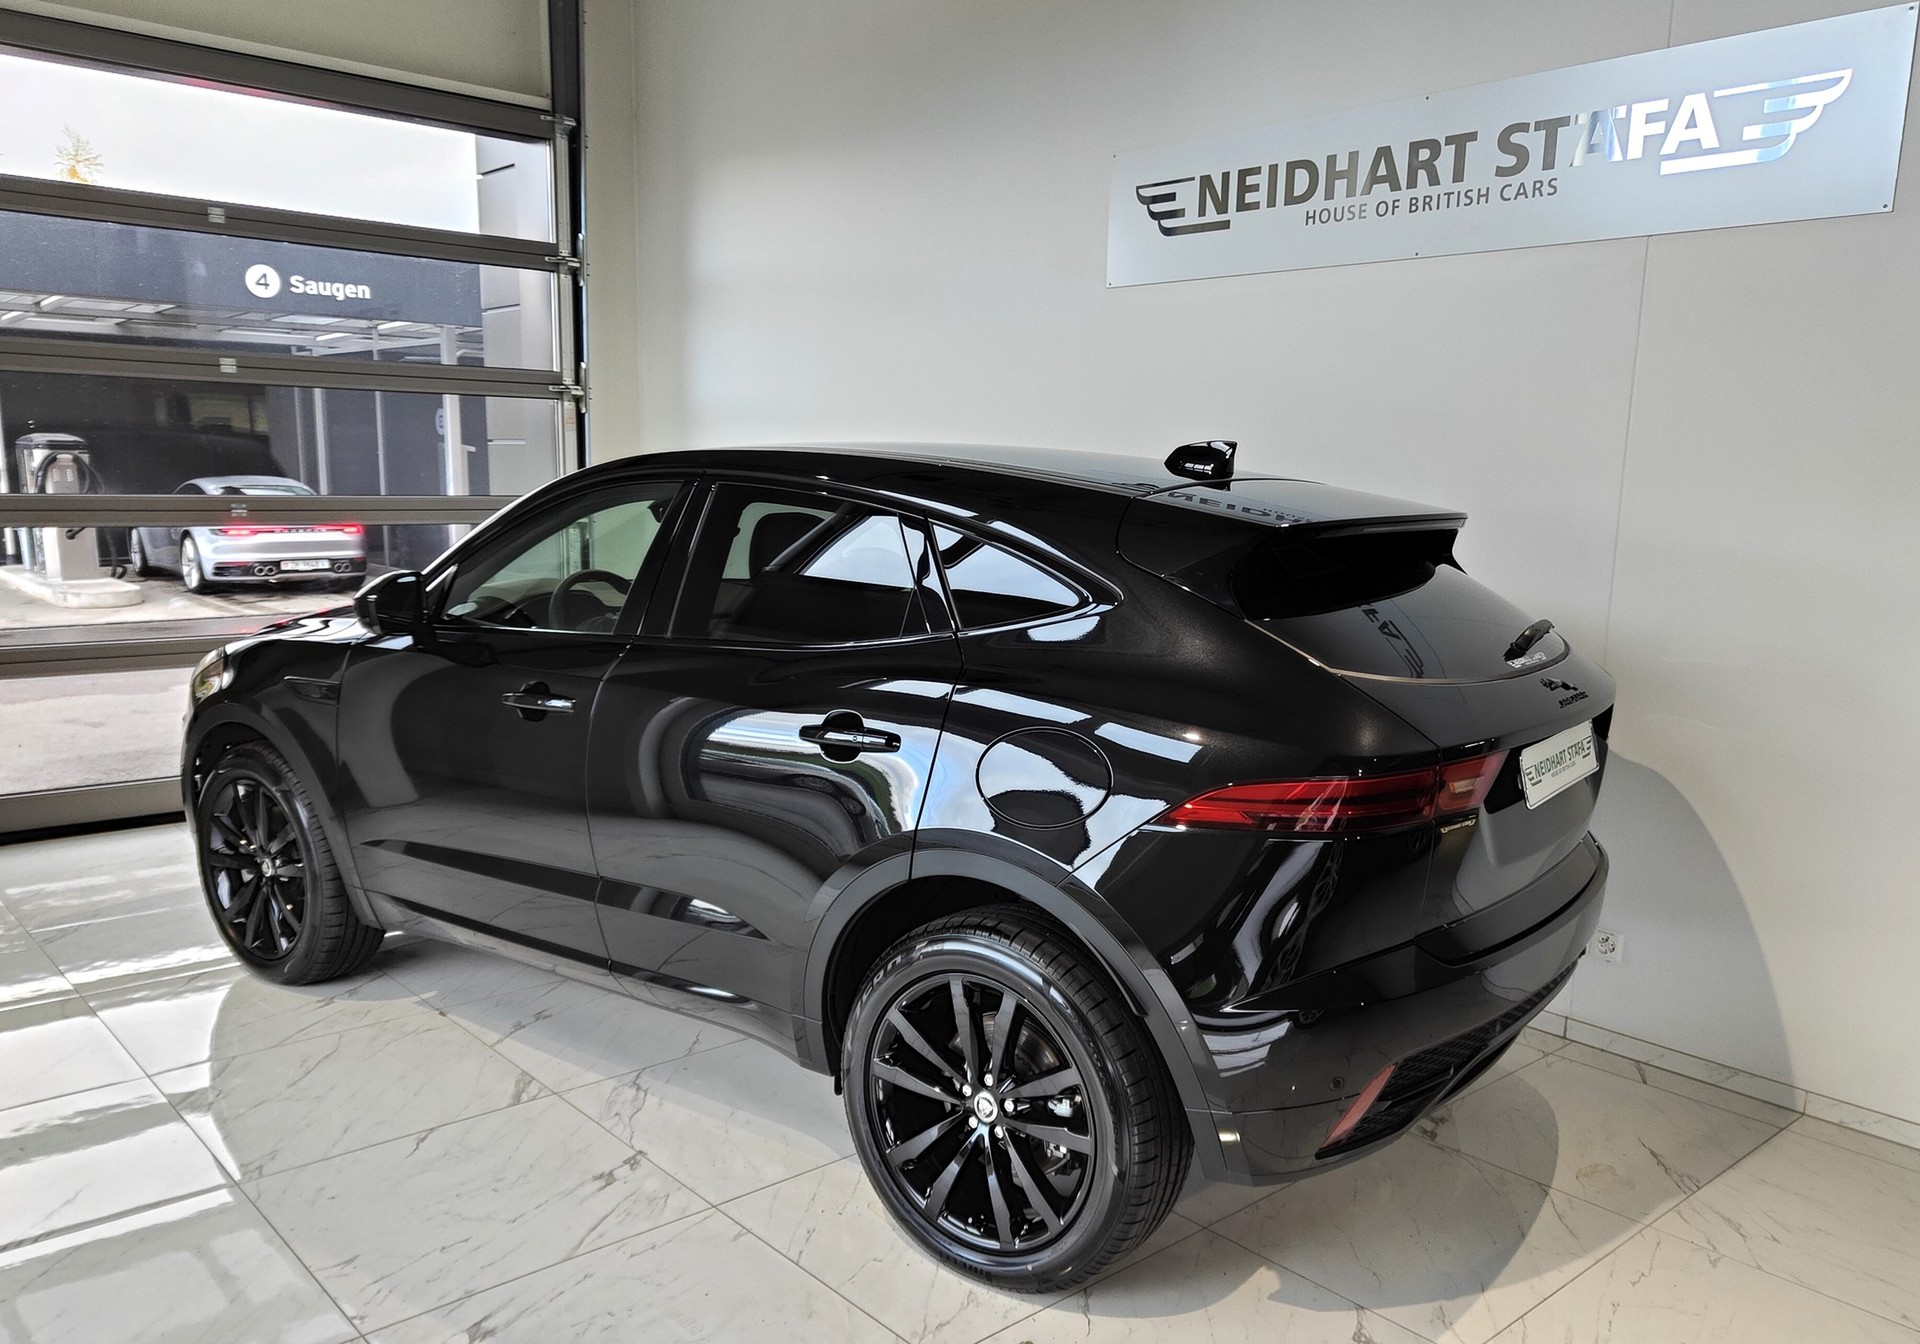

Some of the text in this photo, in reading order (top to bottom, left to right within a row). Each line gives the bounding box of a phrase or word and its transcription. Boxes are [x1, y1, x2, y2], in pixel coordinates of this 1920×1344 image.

[1198, 131, 1478, 217] NEIDHART
[1305, 178, 1557, 226] HOUSE OF BRITISH CARS
[255, 273, 371, 300] 4 Saugen
[1535, 749, 1567, 779] NEIDHART
